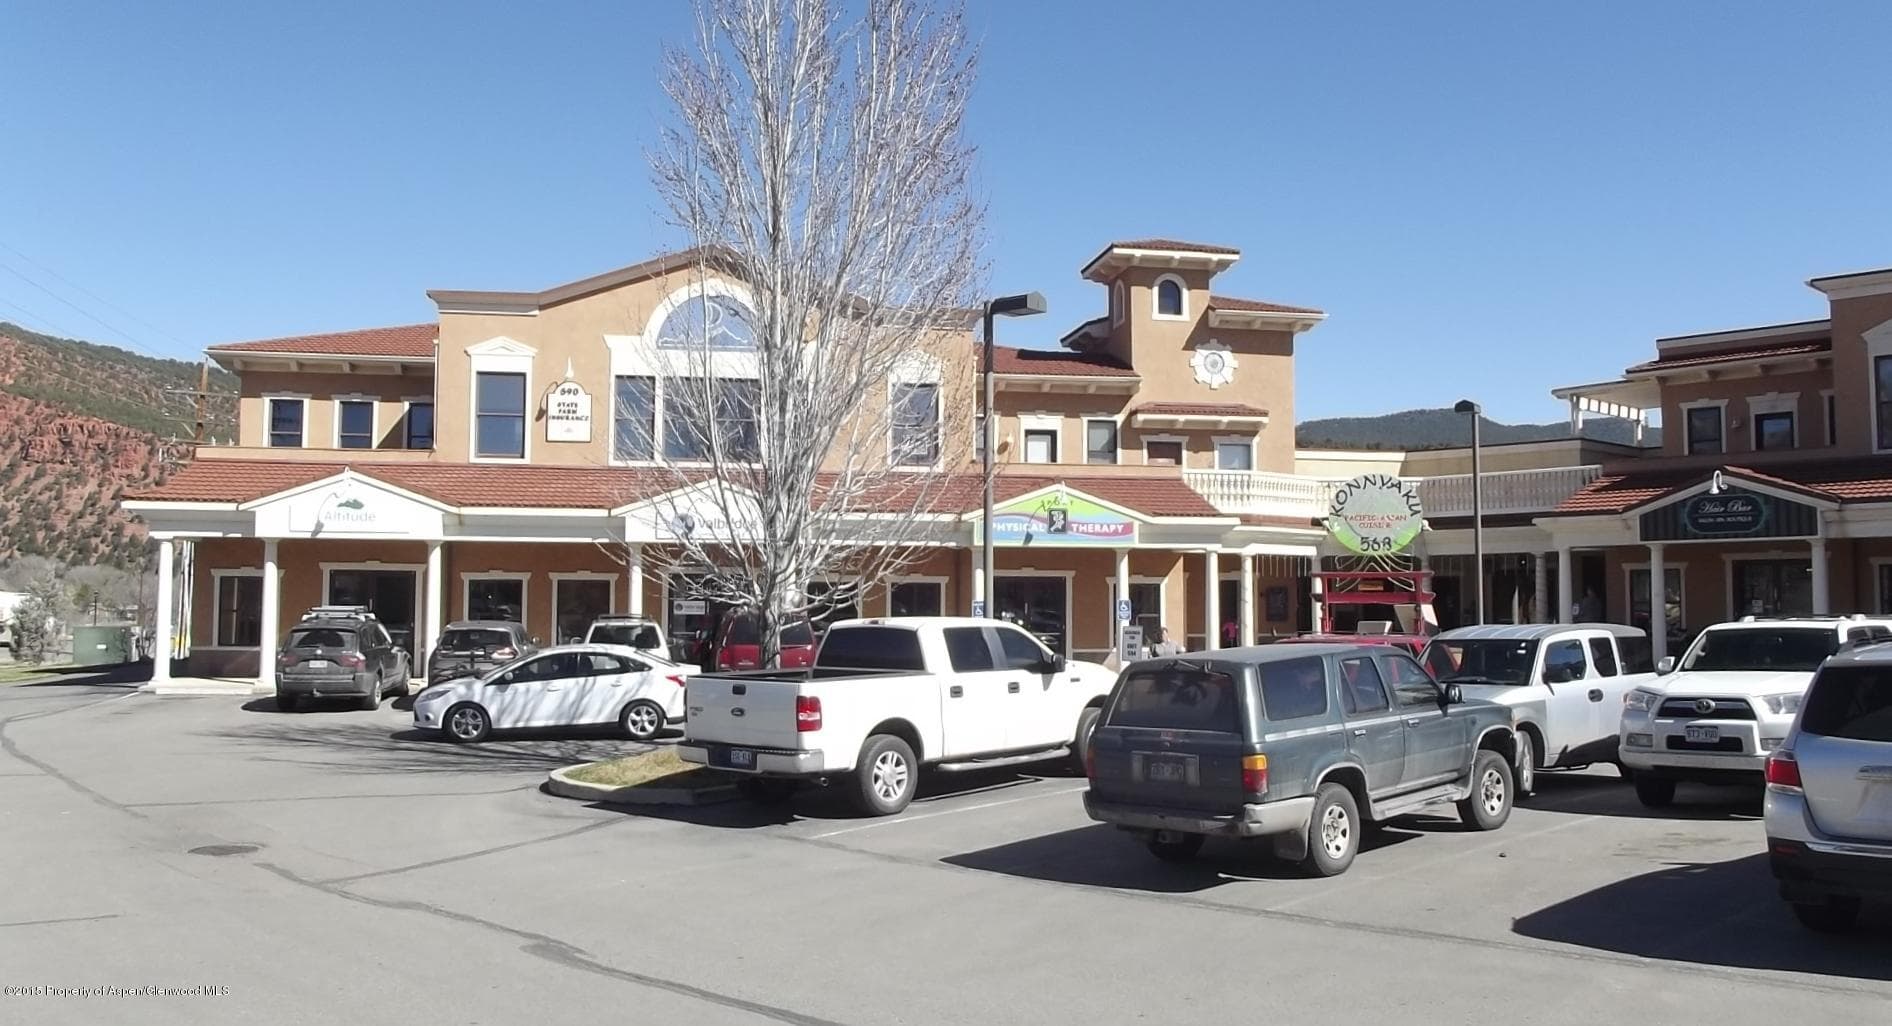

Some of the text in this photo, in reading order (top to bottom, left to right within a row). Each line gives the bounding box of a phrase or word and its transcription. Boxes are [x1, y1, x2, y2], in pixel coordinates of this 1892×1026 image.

[324, 511, 376, 522] Altitude
[992, 522, 1124, 534] PHYSICAL THERAPY
[1360, 536, 1392, 552] 568
